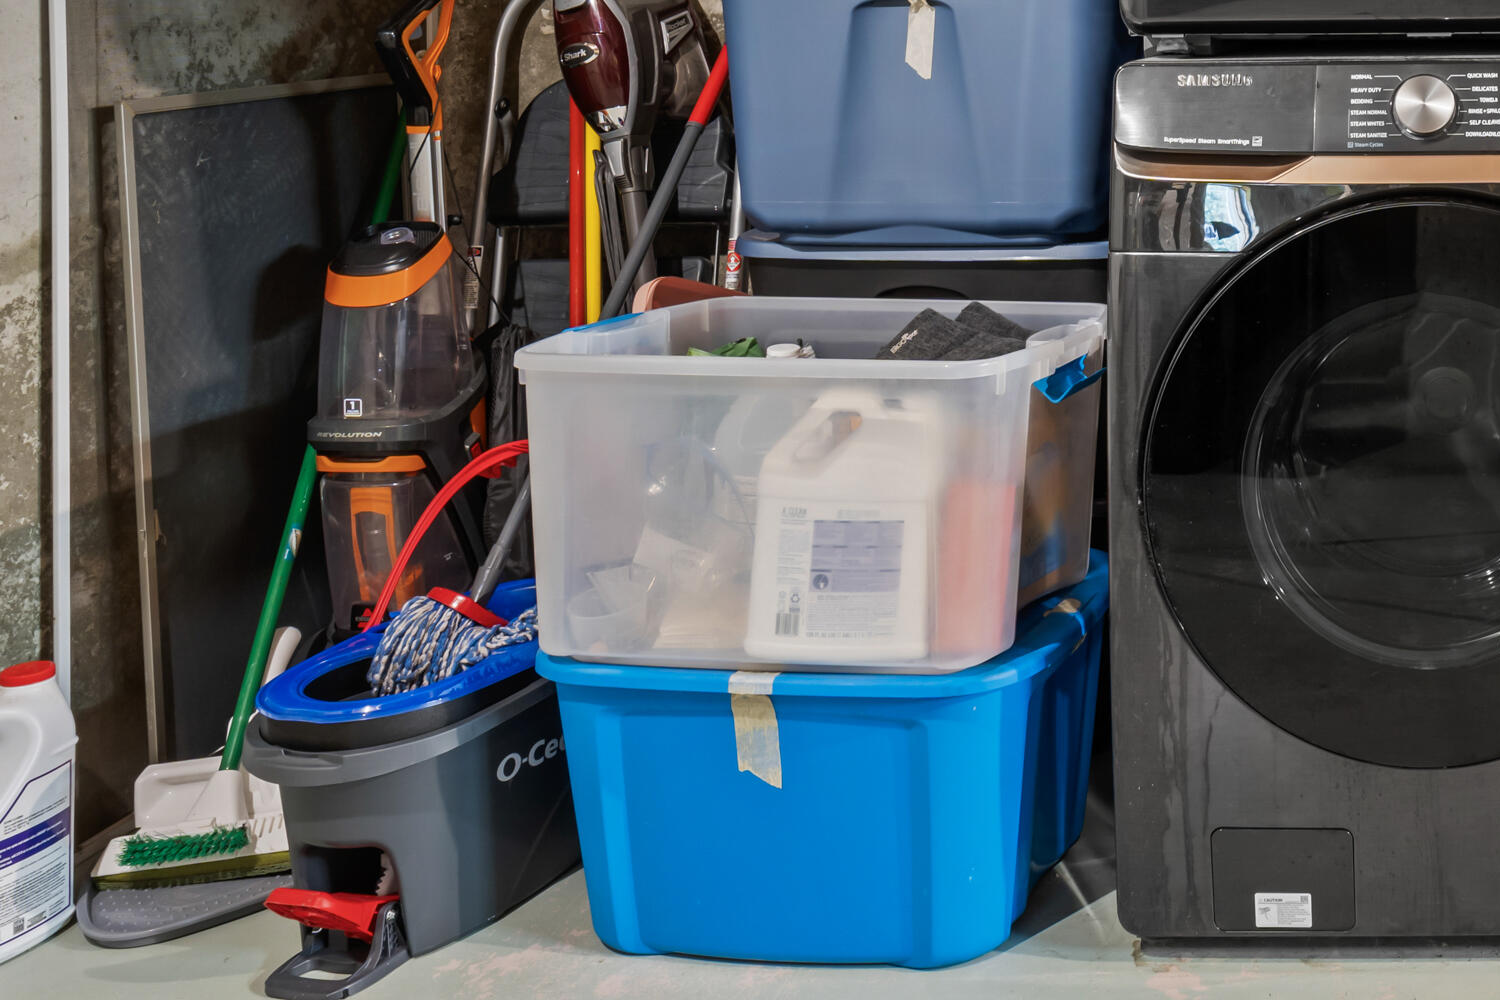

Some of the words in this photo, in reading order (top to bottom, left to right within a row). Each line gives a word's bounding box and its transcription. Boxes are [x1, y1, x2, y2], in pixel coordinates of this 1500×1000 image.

[564, 48, 586, 62] Shark
[1164, 136, 1196, 144] SuperSpeed
[1217, 138, 1250, 146] SmartThings
[350, 401, 355, 410] 1
